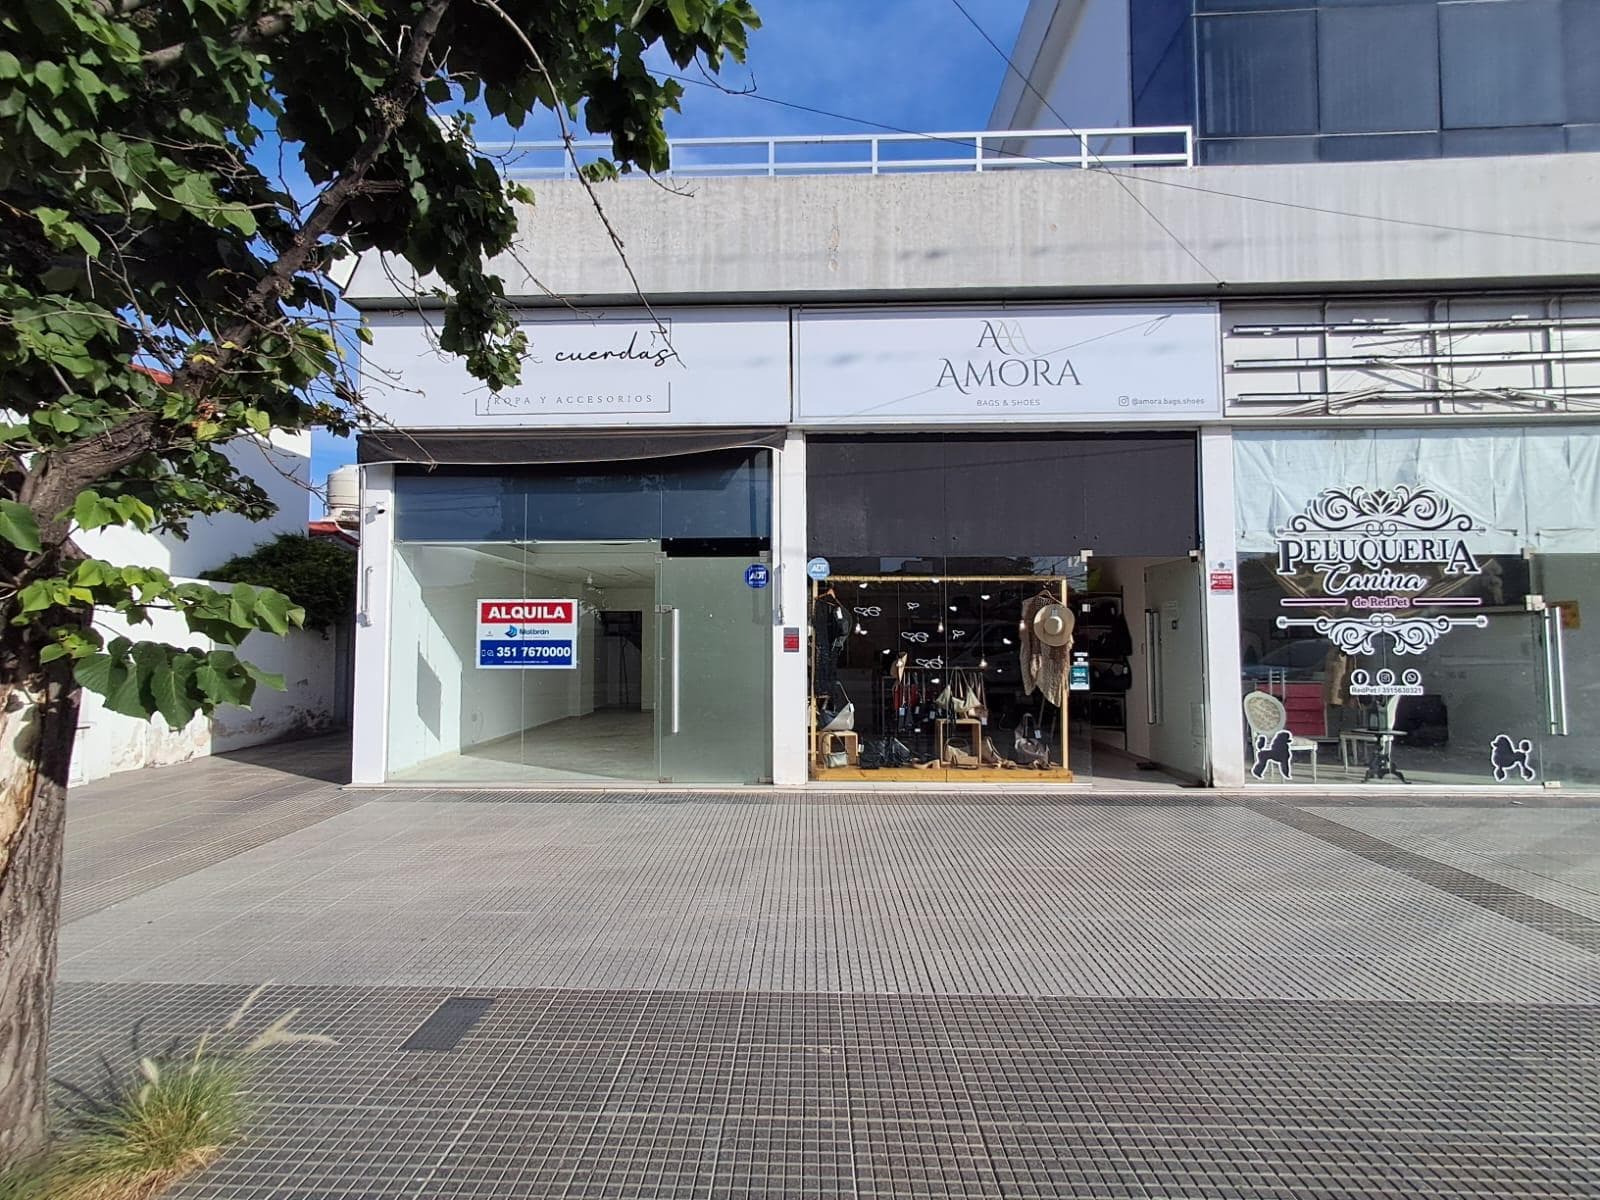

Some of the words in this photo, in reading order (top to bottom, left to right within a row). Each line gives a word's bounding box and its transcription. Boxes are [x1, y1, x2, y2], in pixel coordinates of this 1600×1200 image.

[555, 331, 676, 367] cuerdas
[936, 358, 1082, 394] AMORA
[494, 396, 531, 405] ROPA
[540, 395, 547, 405] Y
[556, 394, 653, 405] ACCESORIOS
[976, 399, 1000, 407] BAGS
[1002, 399, 1009, 407] &
[1011, 399, 1041, 407] SHOES
[1277, 538, 1480, 573] PELUQUERIA
[750, 571, 766, 580] ADT
[1316, 565, 1425, 594] Canina
[1353, 597, 1367, 607] de
[1370, 597, 1408, 607] RedPet
[488, 606, 565, 619] ALQUILA
[496, 647, 517, 657] 351
[522, 646, 571, 657] 7670000
